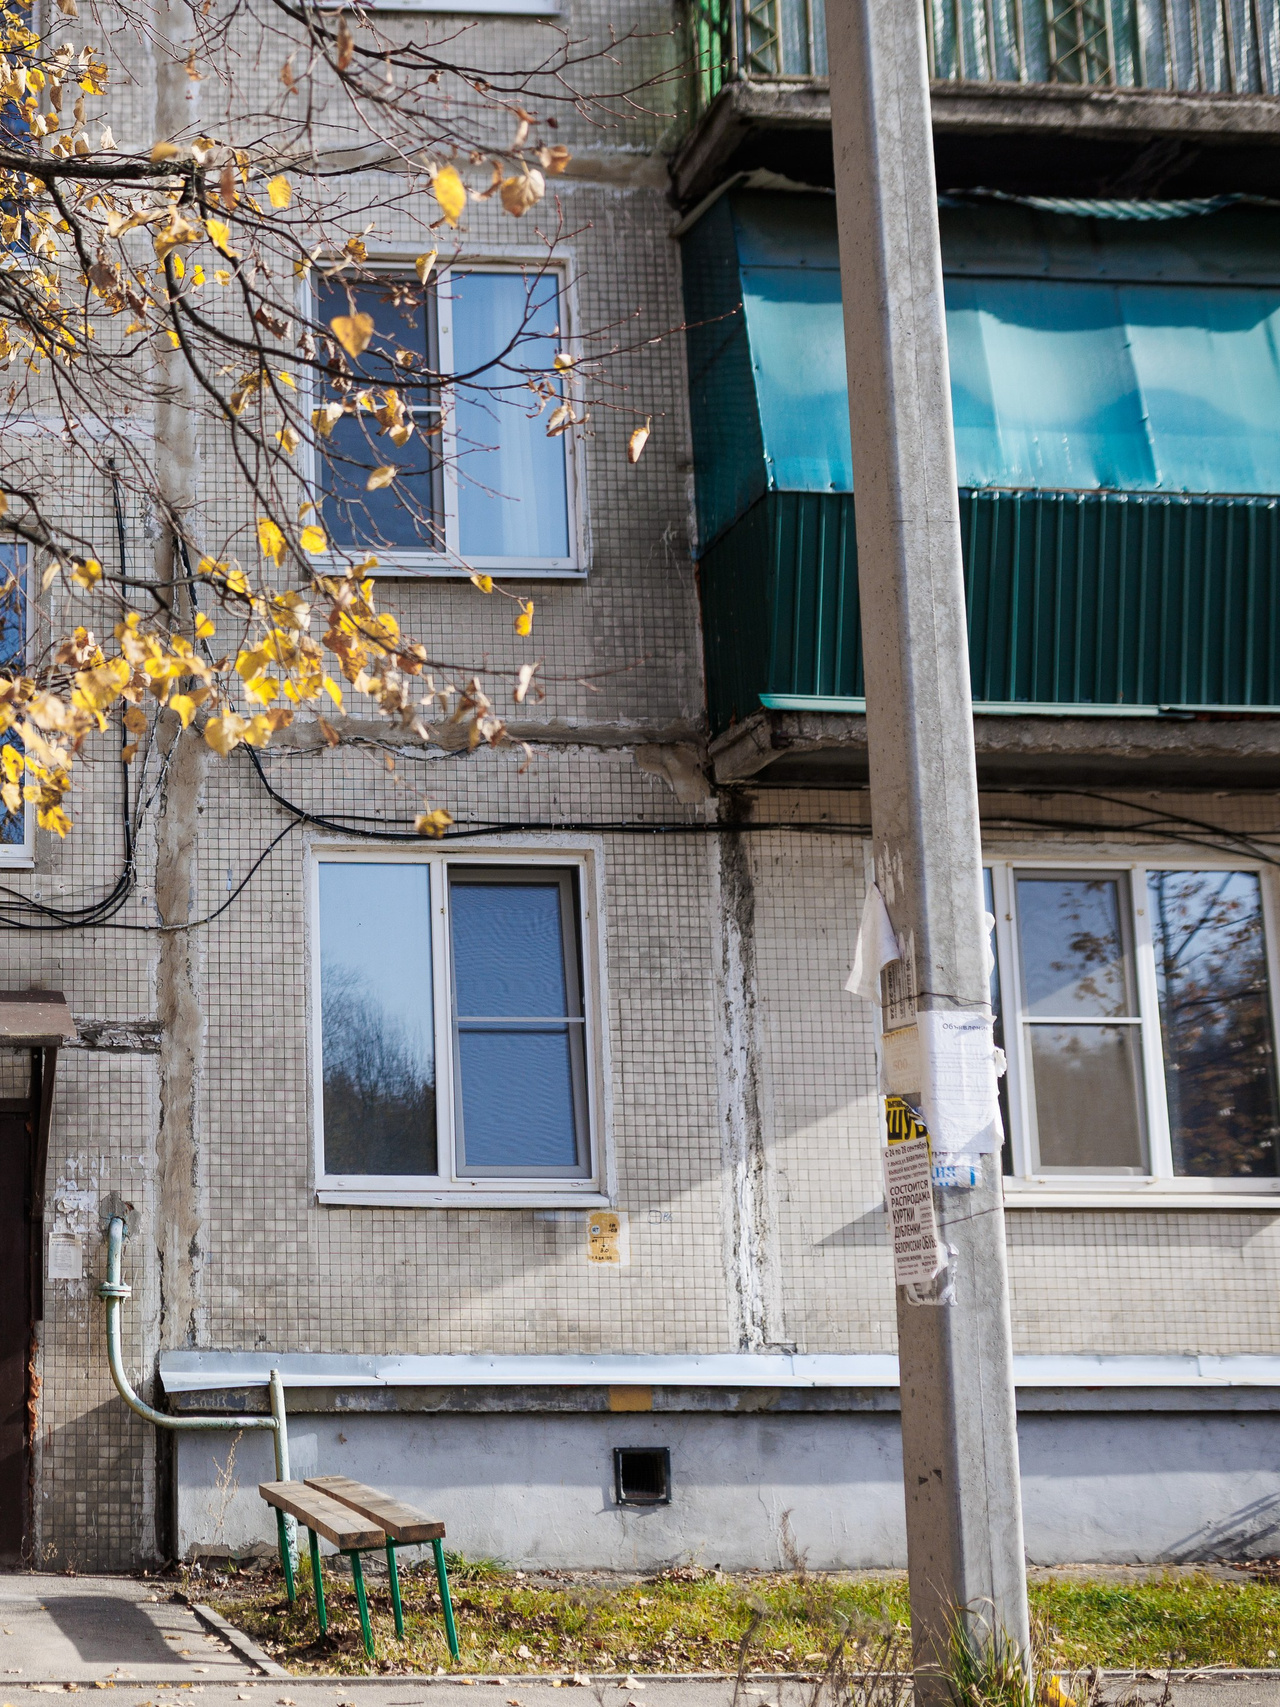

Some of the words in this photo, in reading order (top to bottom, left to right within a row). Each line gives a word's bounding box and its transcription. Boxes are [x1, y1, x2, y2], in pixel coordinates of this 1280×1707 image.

[889, 1149, 894, 1157] 24
[901, 1145, 907, 1154] 28
[907, 1141, 927, 1152] сентября
[890, 1179, 928, 1196] СОСТОИТСЯ
[891, 1191, 931, 1208] РАСПРОДАЖА
[892, 1207, 915, 1224] КУРТКИ
[894, 1222, 921, 1241] ДУБЛЕНКИ
[895, 1240, 921, 1254] БЕЛОРУССКАЯ
[922, 1234, 937, 1250] ОБУВЬ
